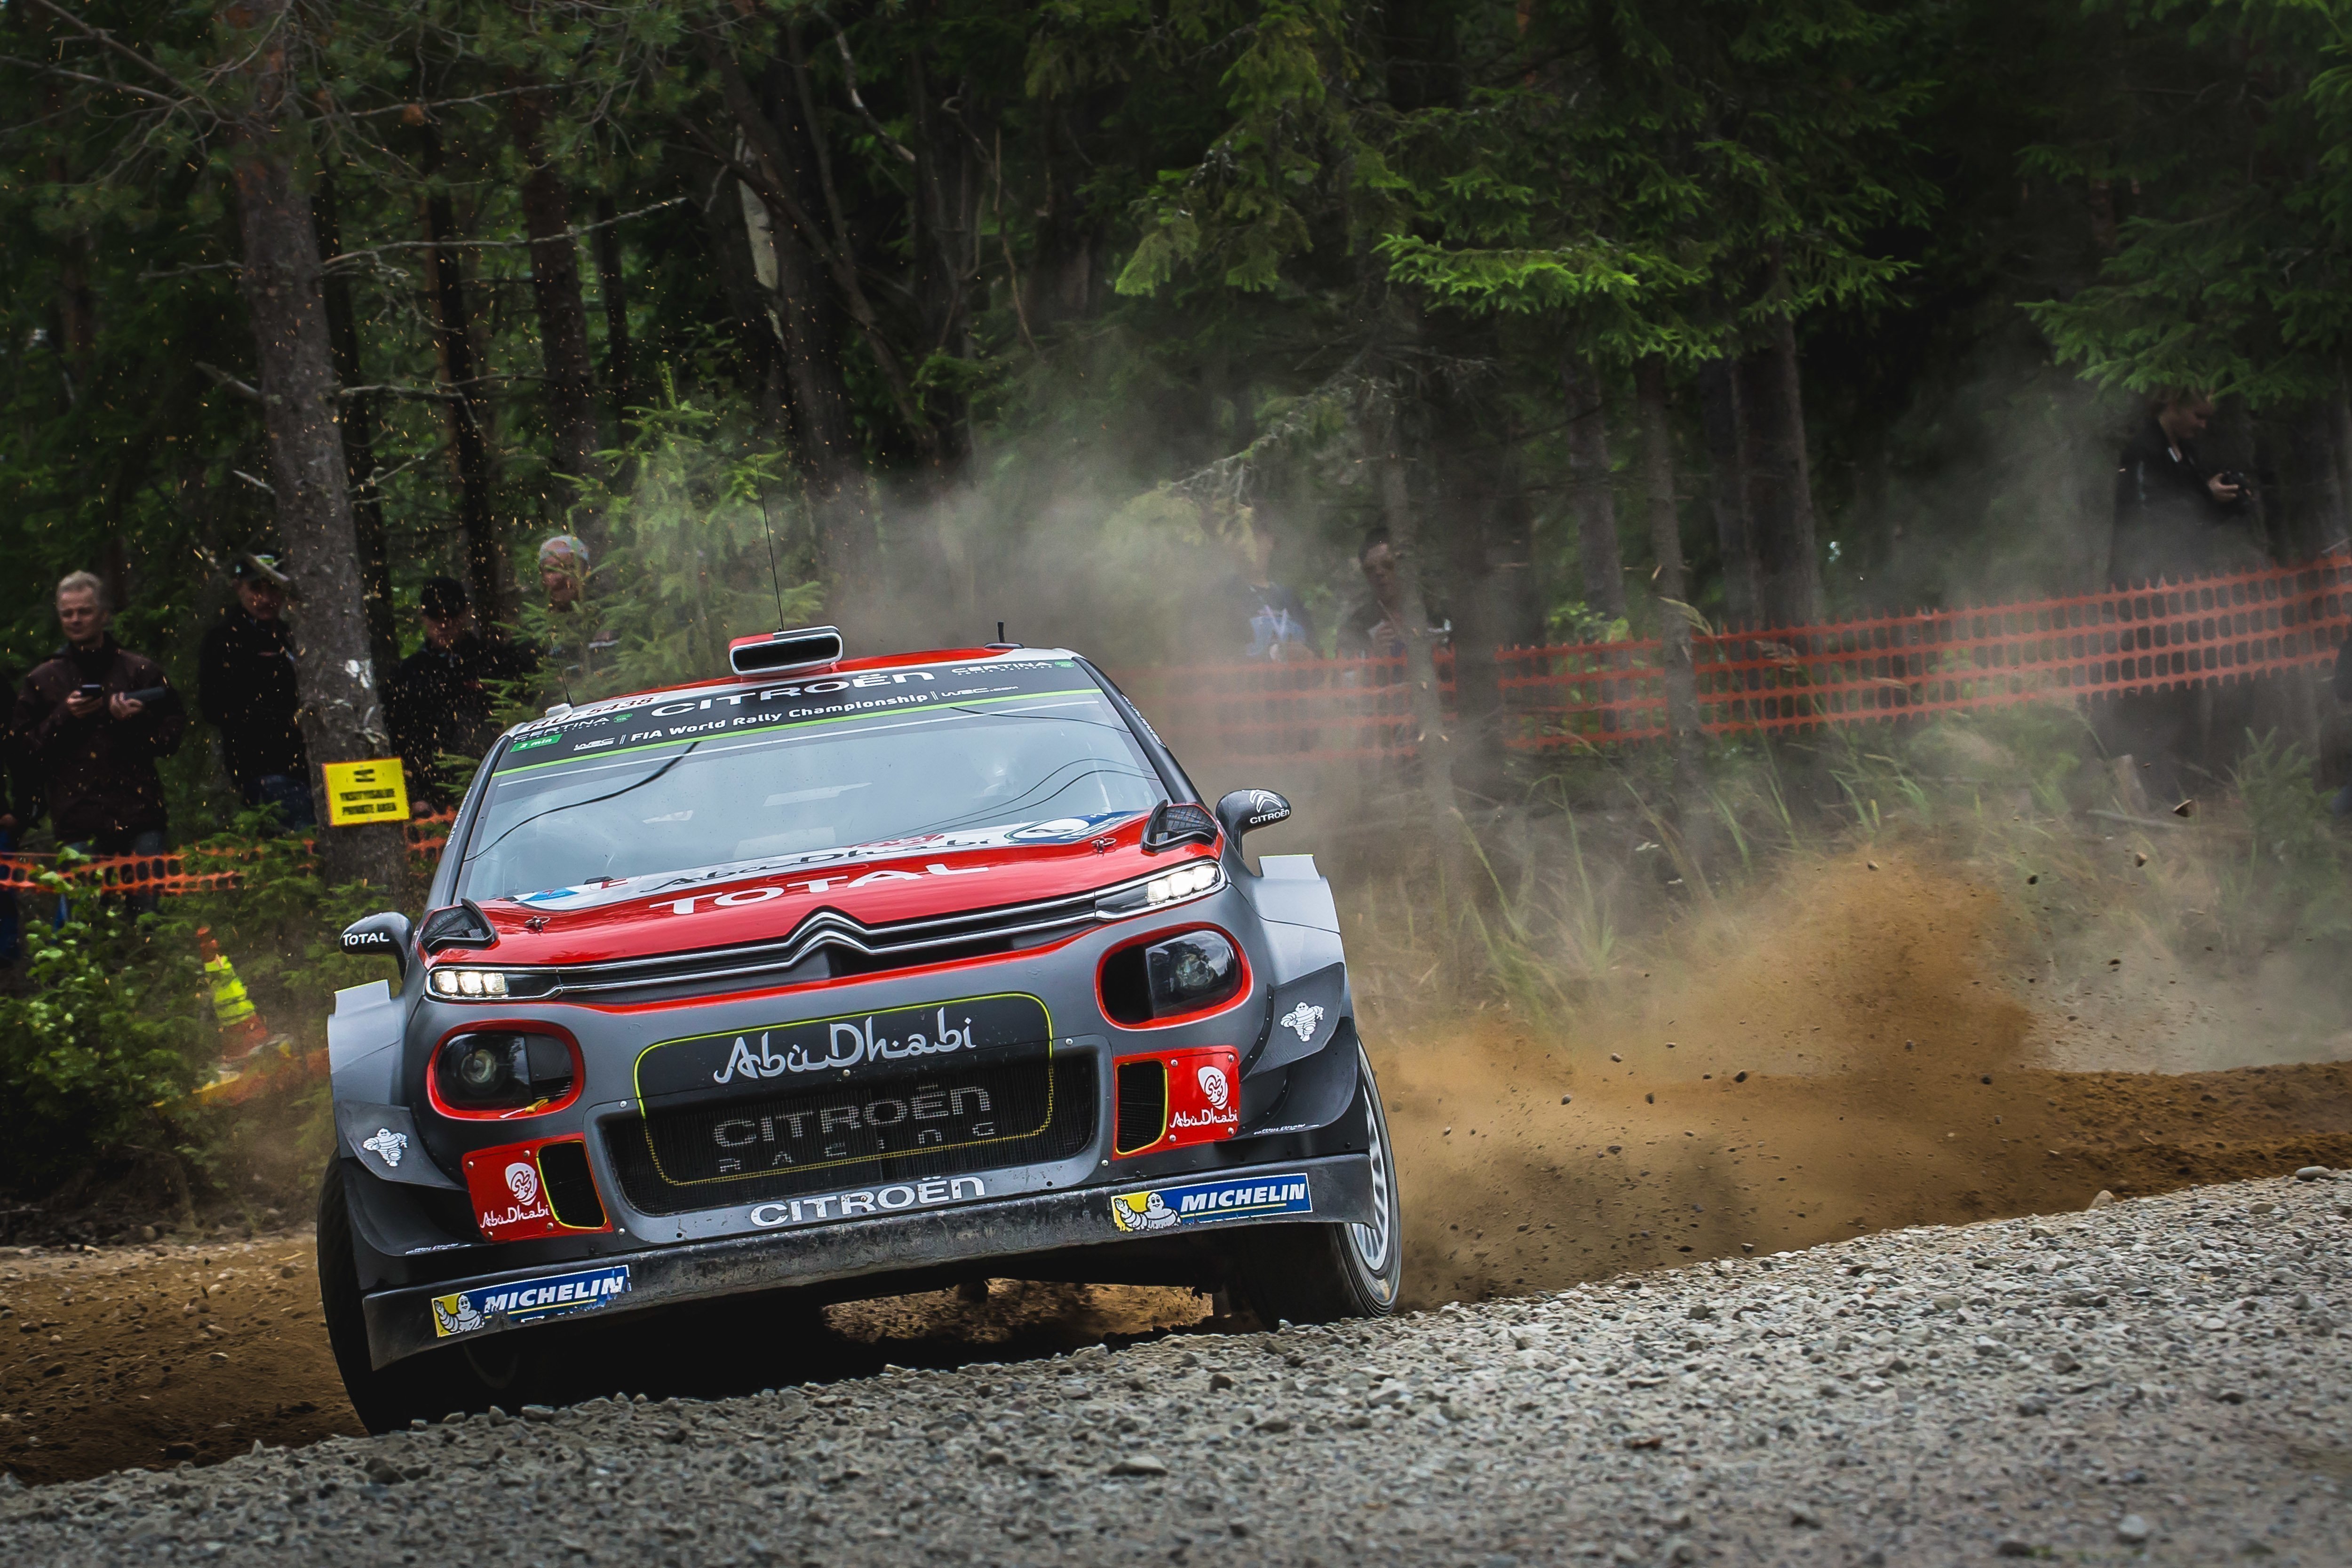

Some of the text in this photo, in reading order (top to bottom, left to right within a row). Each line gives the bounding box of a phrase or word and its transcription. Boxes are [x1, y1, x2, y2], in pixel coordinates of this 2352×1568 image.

[951, 661, 1052, 674] CERTINA
[514, 716, 610, 740] CERTINA
[630, 730, 662, 742] FIA
[669, 719, 726, 735] World
[732, 712, 782, 726] Rally
[788, 693, 928, 718] Championship
[649, 863, 989, 915] TOTAL
[343, 932, 390, 947] TOTAL
[1180, 1183, 1307, 1212] MICHELIN
[484, 1276, 624, 1313] MICHELIN
